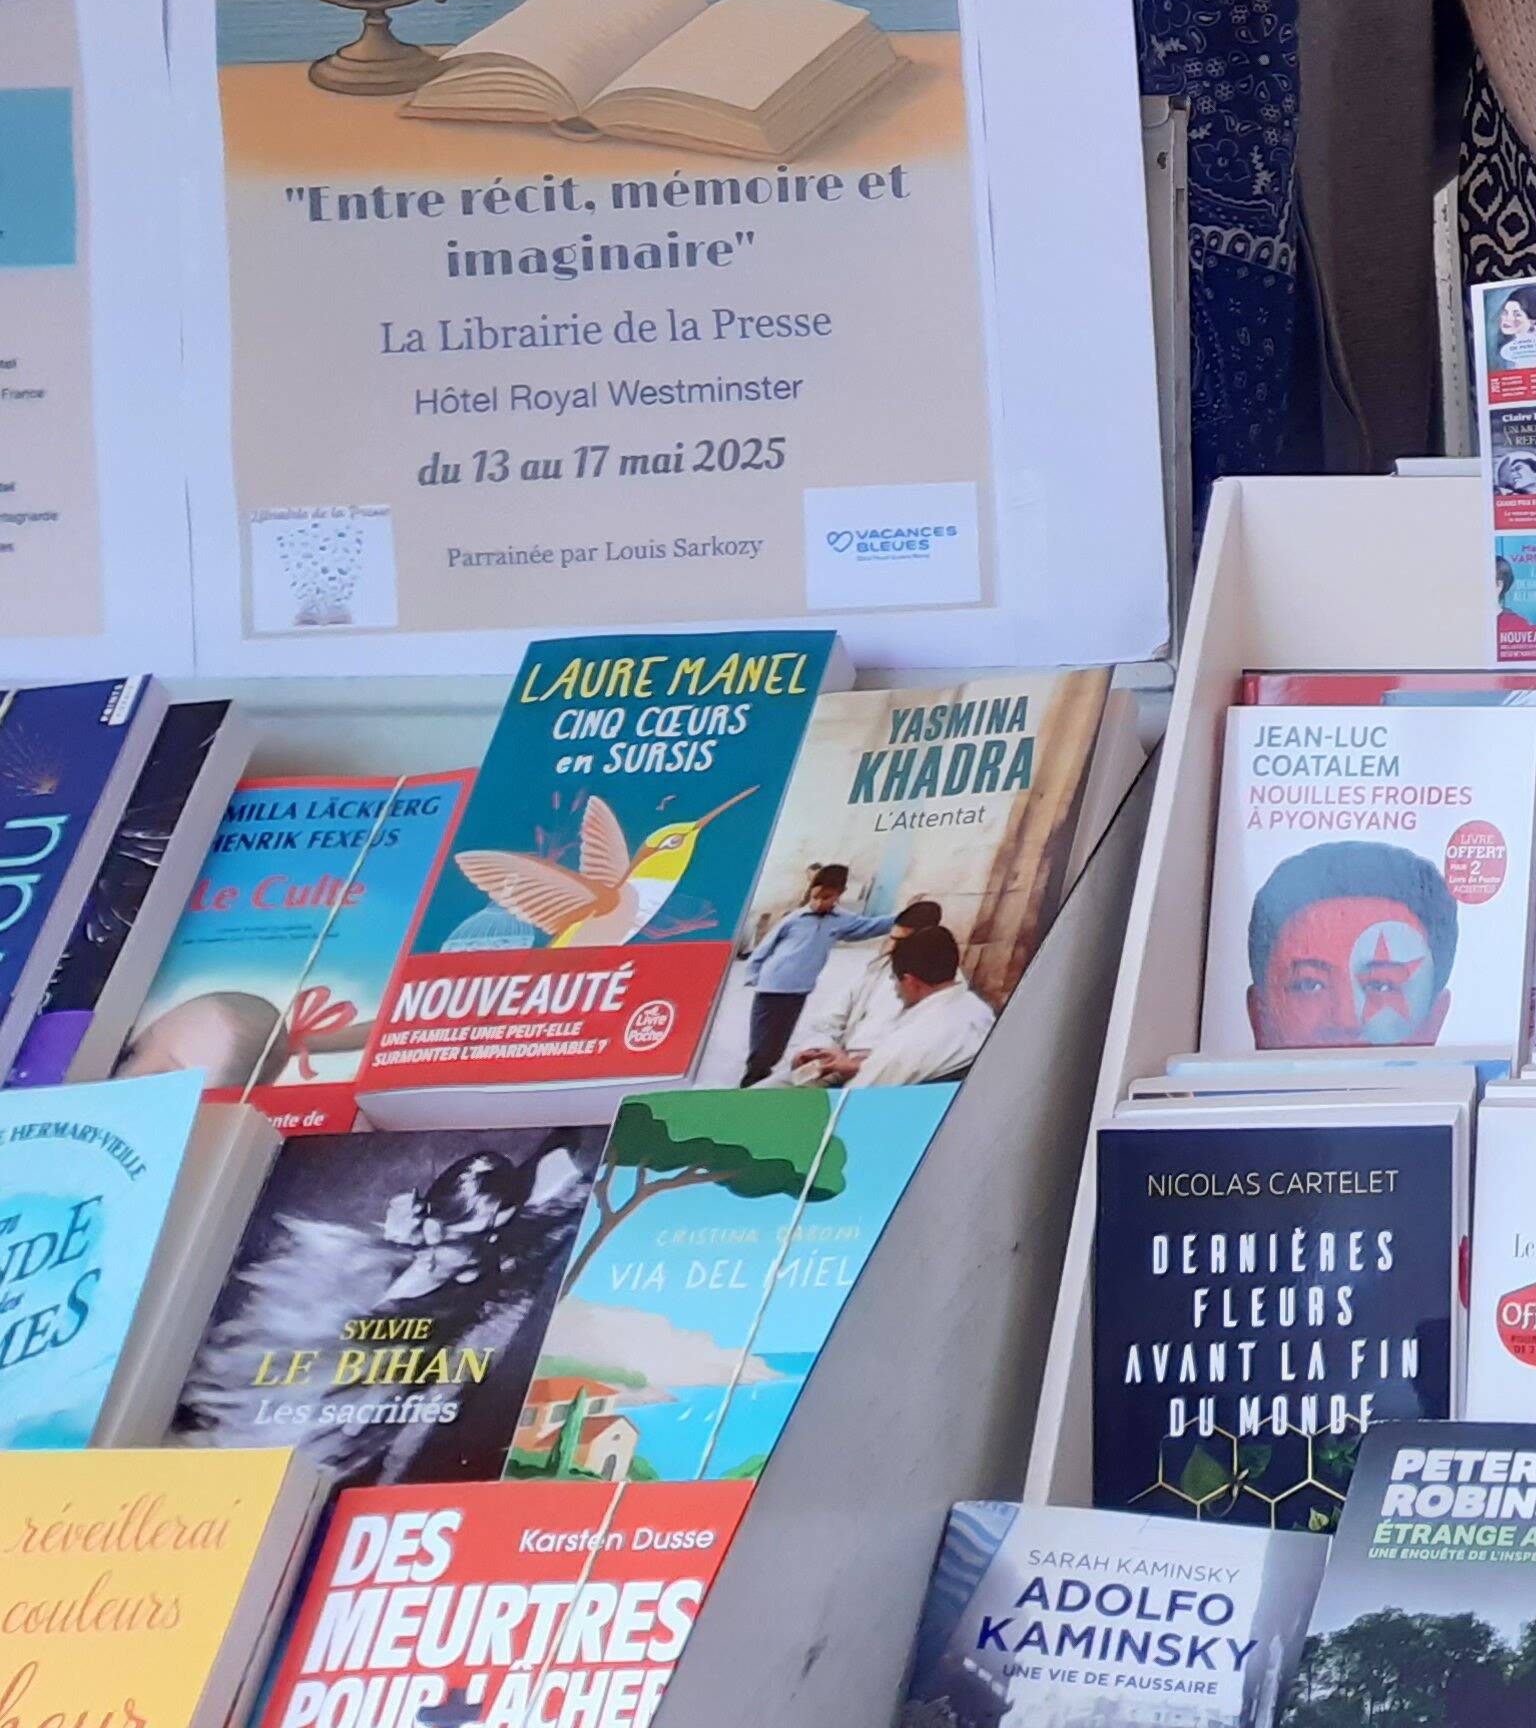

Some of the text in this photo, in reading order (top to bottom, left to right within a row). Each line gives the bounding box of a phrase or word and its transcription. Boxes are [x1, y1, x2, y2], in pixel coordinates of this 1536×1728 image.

[417, 437, 786, 486] du 13 au 17 mai 2025
[520, 652, 808, 703] LAURE MANEL
[552, 705, 621, 741] CINQ
[889, 696, 1026, 742] YASMINA
[1254, 725, 1388, 749] JEAN-LUC
[556, 741, 718, 776] en SURSIS
[848, 738, 1035, 804] KHADRA
[1253, 755, 1399, 777] COATALEM
[1249, 786, 1472, 806] NOUILLES FROIDES
[874, 805, 985, 833] L'Attentat
[1248, 806, 1417, 832] À PYONGYANG
[397, 962, 636, 1022] NOUVEAUTÉ
[1148, 1170, 1399, 1197] NICOLAS CARTELET
[1152, 1227, 1395, 1274] DERNIÈRES
[1193, 1286, 1354, 1328] FLEURS
[342, 1318, 432, 1340] SYLVIE
[255, 1346, 494, 1386] LE BIHAN
[255, 1394, 459, 1427] Les sacrifiés
[333, 1510, 463, 1590] DES
[520, 1525, 715, 1552] Karsten Dusse
[1015, 1577, 1234, 1627] ADOLFO
[976, 1615, 1259, 1672] KAMINSKY
